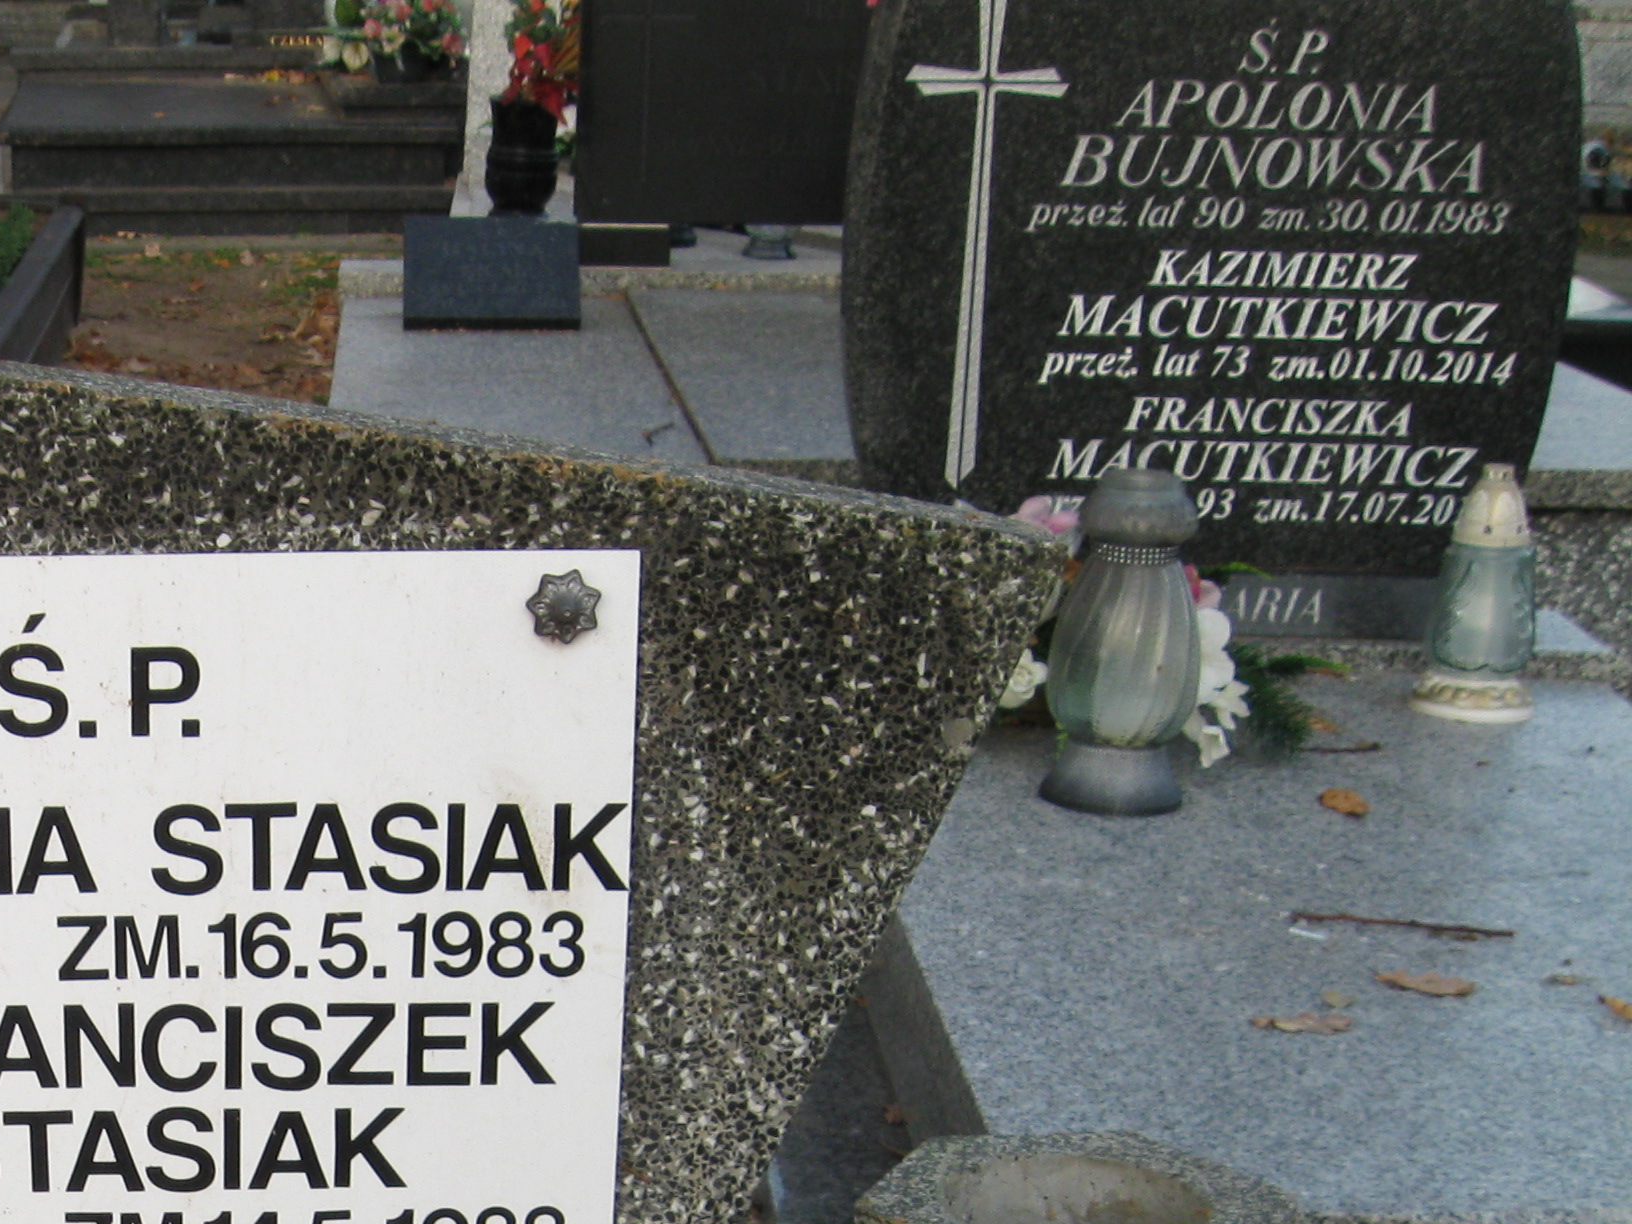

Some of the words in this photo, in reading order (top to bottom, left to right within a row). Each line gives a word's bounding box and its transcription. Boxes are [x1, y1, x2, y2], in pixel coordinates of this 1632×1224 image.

[1114, 78, 1438, 133] APOLONIA
[1059, 133, 1485, 194] BUJNOWSKA
[1024, 198, 1128, 233] przeż.
[1138, 196, 1182, 228] lat
[1193, 196, 1246, 231] 90
[1147, 249, 1418, 290] KAZIMIERZ
[1056, 294, 1500, 345] MACUTKIEWICZ
[1037, 347, 1139, 385] przeż.
[1152, 344, 1200, 377] lat
[1211, 345, 1253, 378] 73
[1123, 395, 1414, 437] FRANCISZKA
[1046, 437, 1479, 488] MACUTKIEWICZ
[1196, 487, 1236, 521] 93
[1231, 586, 1323, 625] ARIA
[151, 802, 628, 896] STASIAK
